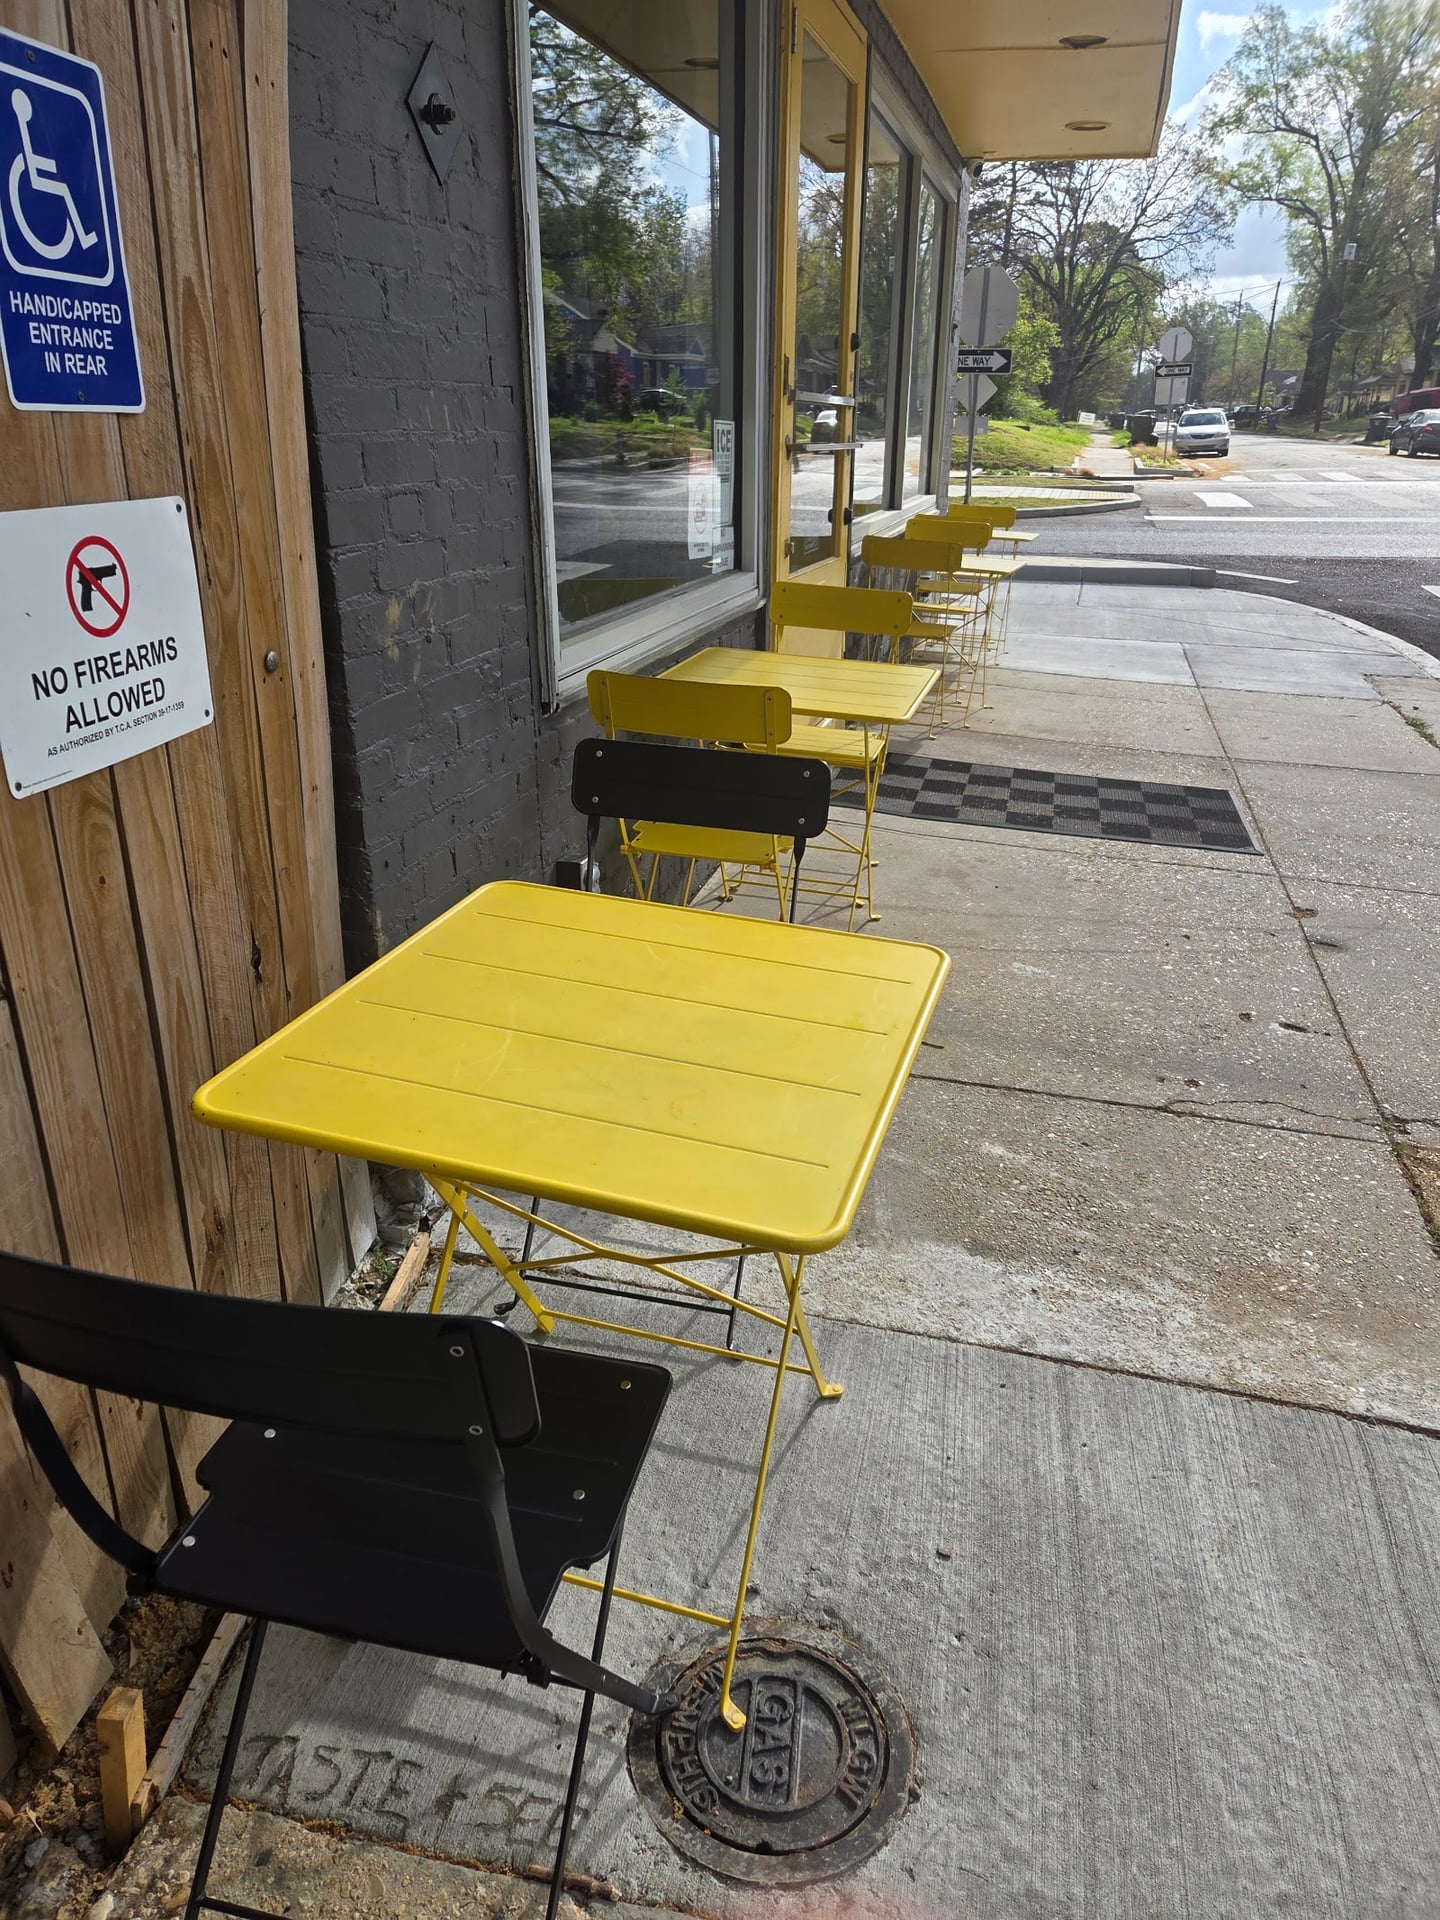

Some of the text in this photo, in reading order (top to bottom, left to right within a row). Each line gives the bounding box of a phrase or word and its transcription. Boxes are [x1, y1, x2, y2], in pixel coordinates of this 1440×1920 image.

[9, 290, 122, 325] HANDICAPPED
[29, 322, 114, 351] ENTRANCE
[44, 351, 108, 376] IN REAR
[957, 356, 991, 366] NE WAY
[717, 428, 731, 453] ICE
[31, 636, 178, 700] NO FIREARMS
[65, 677, 166, 733] ALLOWED
[47, 747, 58, 758] AS
[59, 730, 104, 753] AUTHORIZED
[105, 727, 114, 738] BY
[115, 723, 132, 733] T.C.A.
[133, 712, 158, 728] SECTION
[668, 1664, 724, 1812] MEMPHIS
[752, 1693, 795, 1786] GAS
[244, 1734, 424, 1822] TASTE
